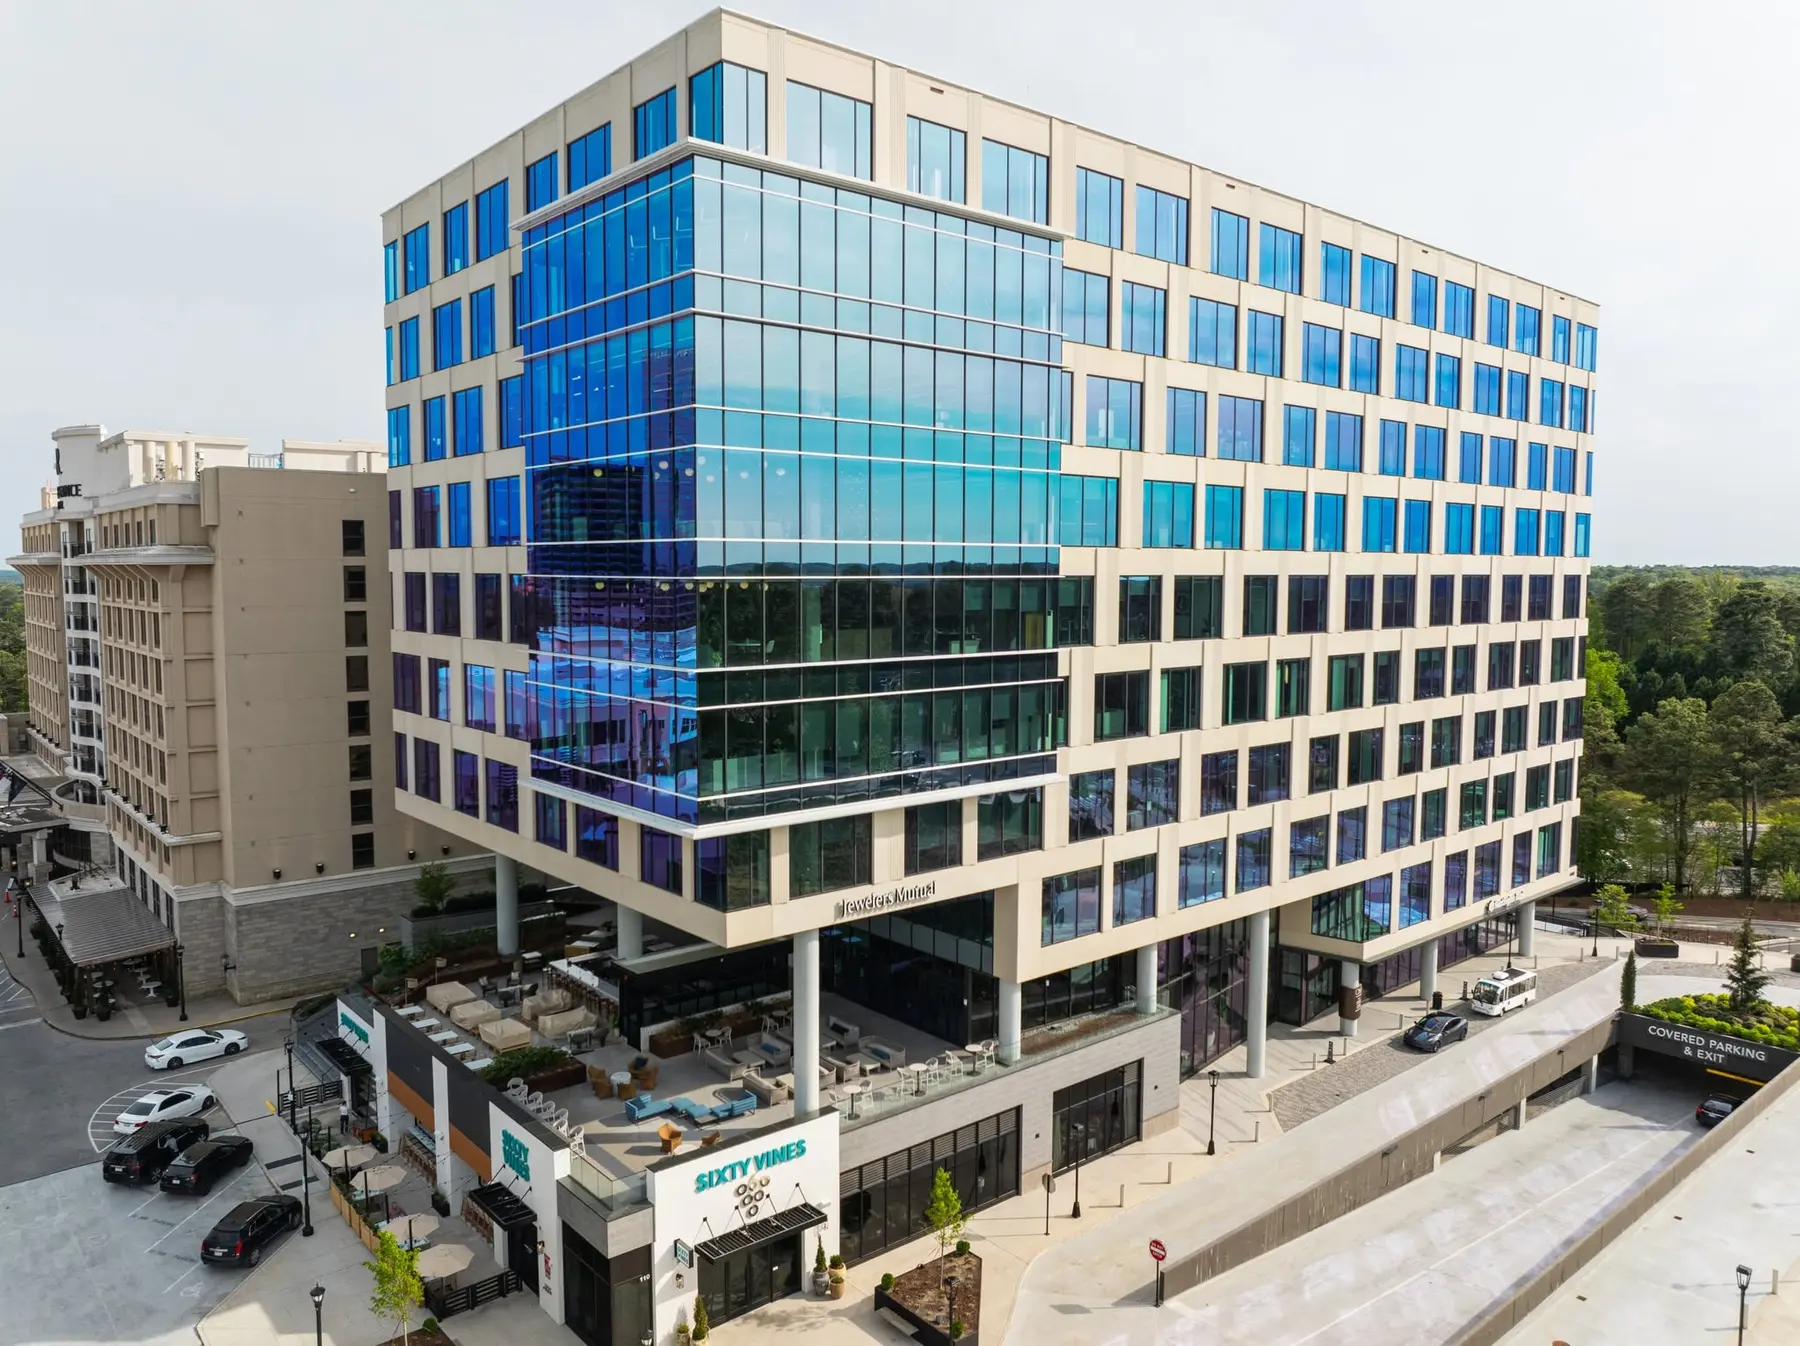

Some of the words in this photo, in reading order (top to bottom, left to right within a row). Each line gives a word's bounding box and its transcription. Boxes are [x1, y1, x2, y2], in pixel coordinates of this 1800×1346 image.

[841, 892, 894, 917] Jewelers
[894, 880, 936, 902] Mutual
[1648, 1025, 1705, 1046] COVERED
[1709, 1040, 1766, 1061] PARKING
[1683, 1046, 1693, 1056] &
[1697, 1049, 1725, 1063] EXIT
[696, 1157, 752, 1193] SIXTY
[754, 1139, 807, 1171] VINES
[640, 1273, 650, 1282] 110
